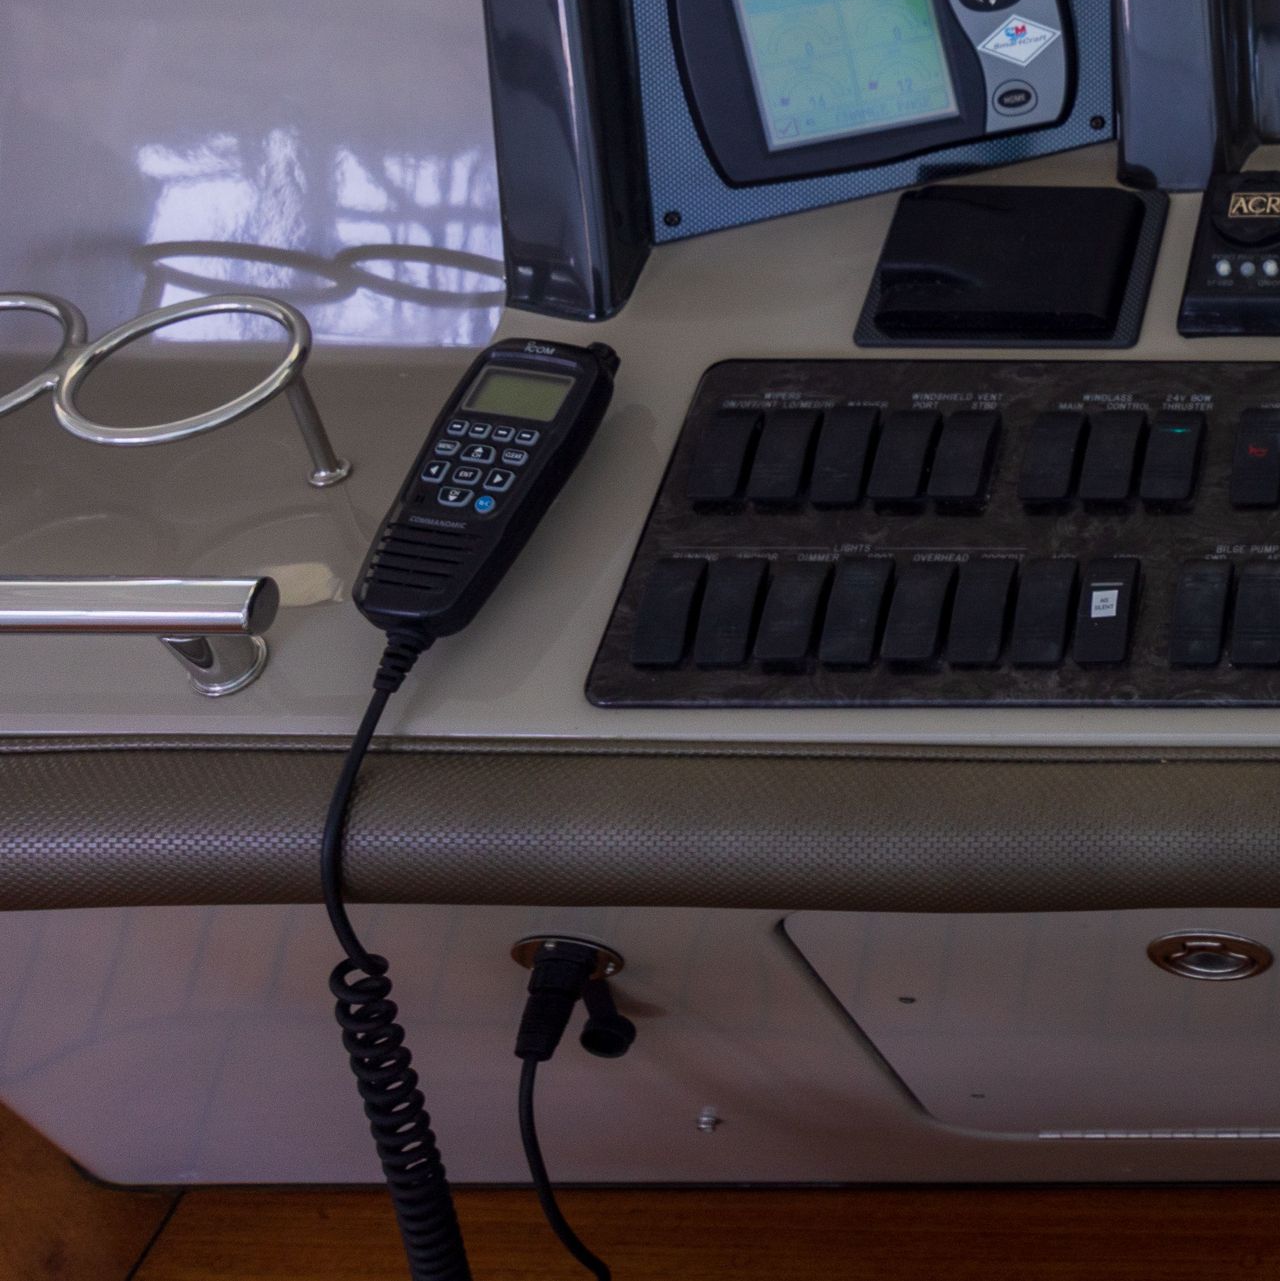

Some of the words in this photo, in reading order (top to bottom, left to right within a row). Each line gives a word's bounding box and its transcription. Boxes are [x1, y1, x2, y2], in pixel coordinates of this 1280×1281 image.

[912, 392, 973, 401] WINDSHIELD
[976, 392, 1004, 401] VENT
[1082, 393, 1133, 402] WINDLASS
[912, 401, 939, 409] PORT
[1058, 402, 1085, 410] MAIN
[1106, 402, 1151, 411] CONTROL
[1162, 402, 1214, 411] THRUSTER
[833, 543, 871, 553] LIGHTS
[1216, 545, 1245, 554] BILGE
[1249, 545, 1280, 554] PUMP
[797, 552, 840, 562] DIMMER
[913, 552, 970, 562] OVERHEAD
